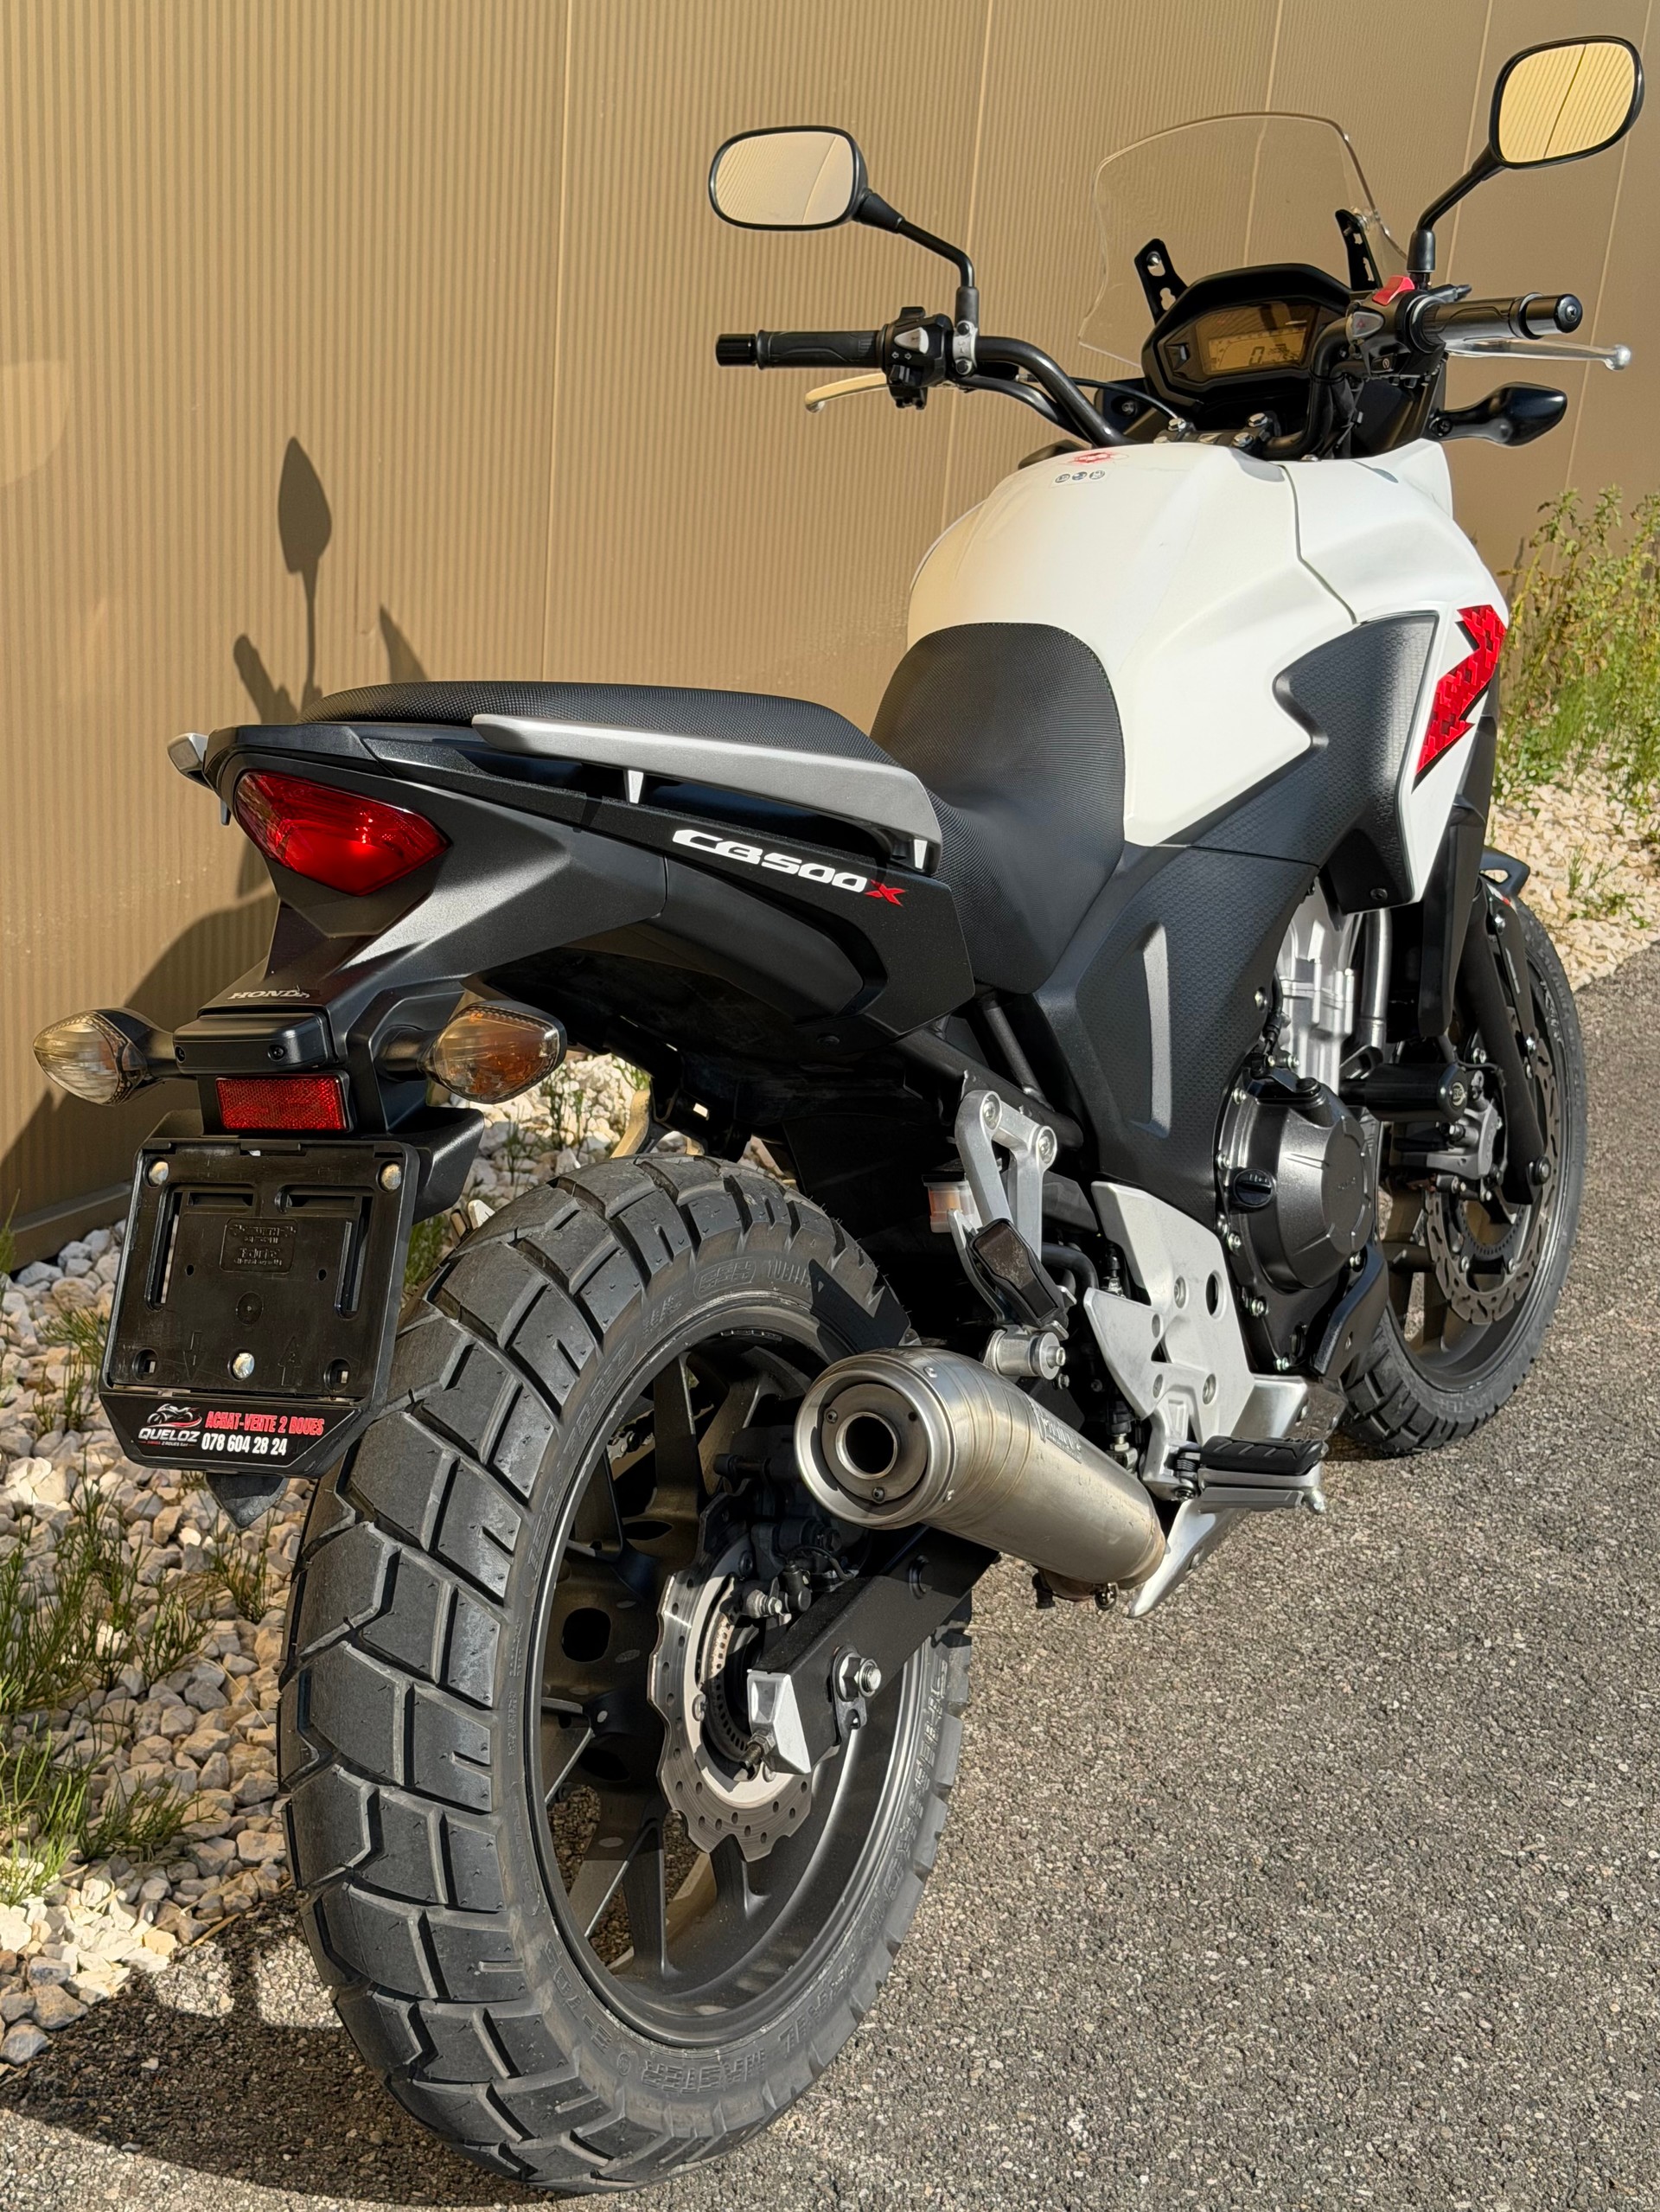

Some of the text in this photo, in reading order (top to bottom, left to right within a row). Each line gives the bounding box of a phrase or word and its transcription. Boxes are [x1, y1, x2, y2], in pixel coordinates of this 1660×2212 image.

[205, 1411, 325, 1435] ACHAT-VENTE 2 ROUES
[138, 1428, 201, 1442] QUELOZ
[201, 1432, 288, 1455] 078 604 28 24
